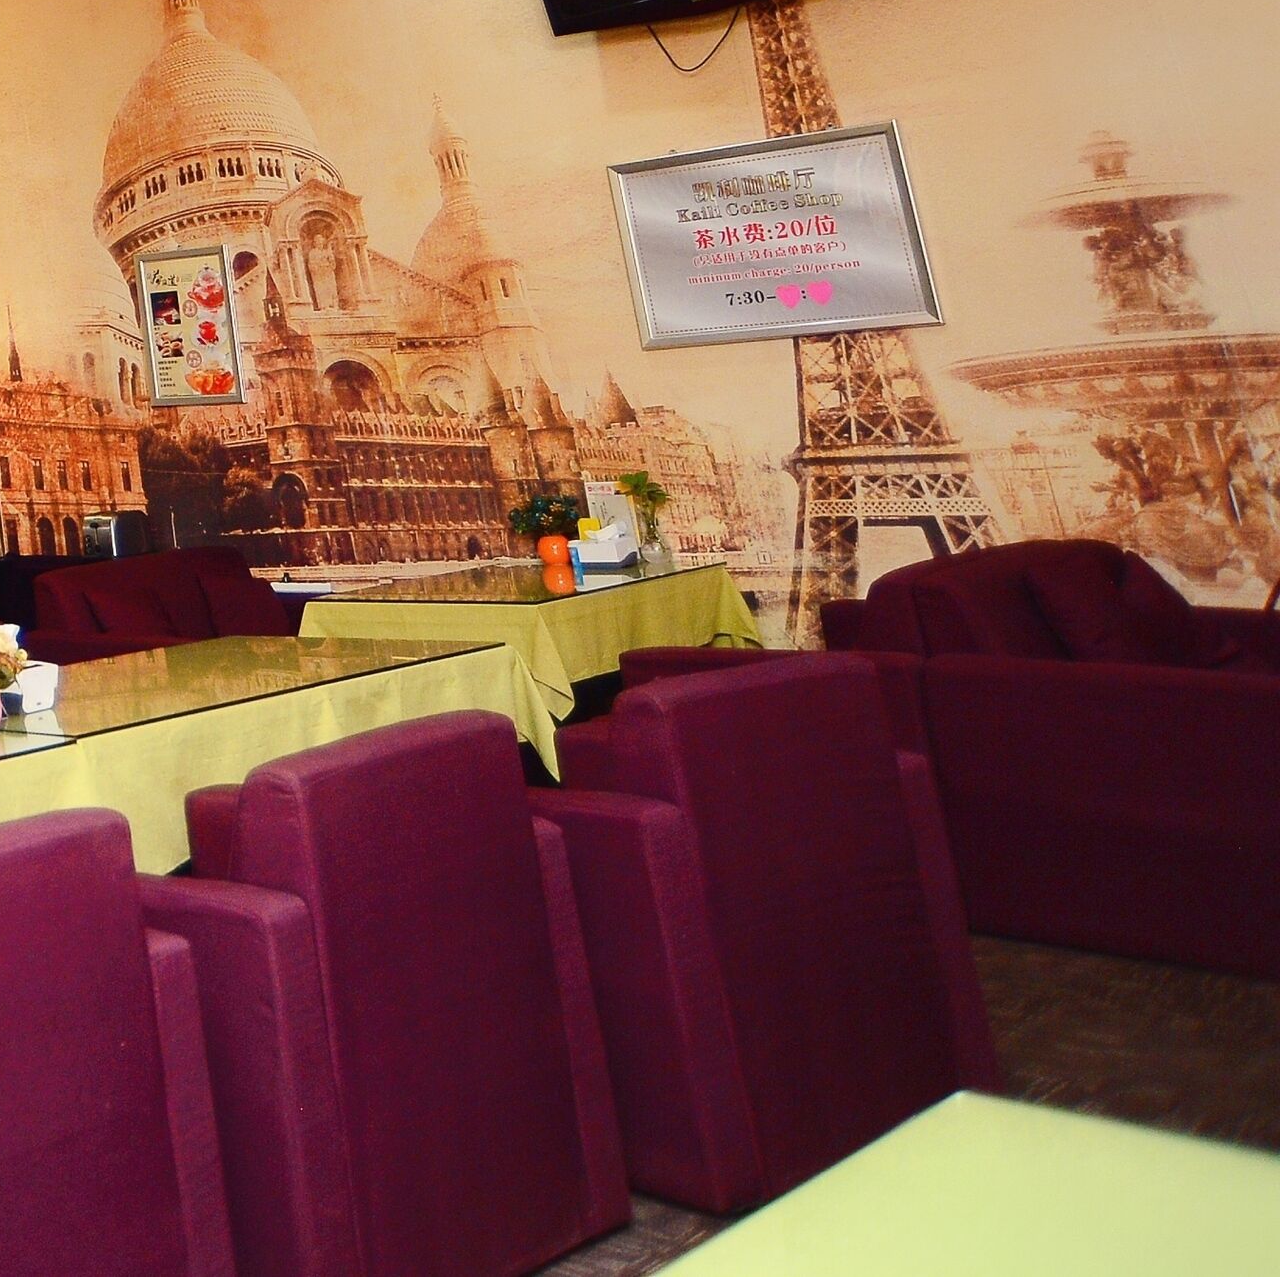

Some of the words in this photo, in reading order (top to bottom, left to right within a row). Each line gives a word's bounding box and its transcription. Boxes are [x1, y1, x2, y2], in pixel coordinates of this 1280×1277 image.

[691, 167, 815, 204] 凯利咖啡厅
[676, 203, 722, 223] Kaili
[726, 199, 789, 217] Coffee
[794, 192, 844, 209] Shop
[795, 260, 861, 275] 20/person
